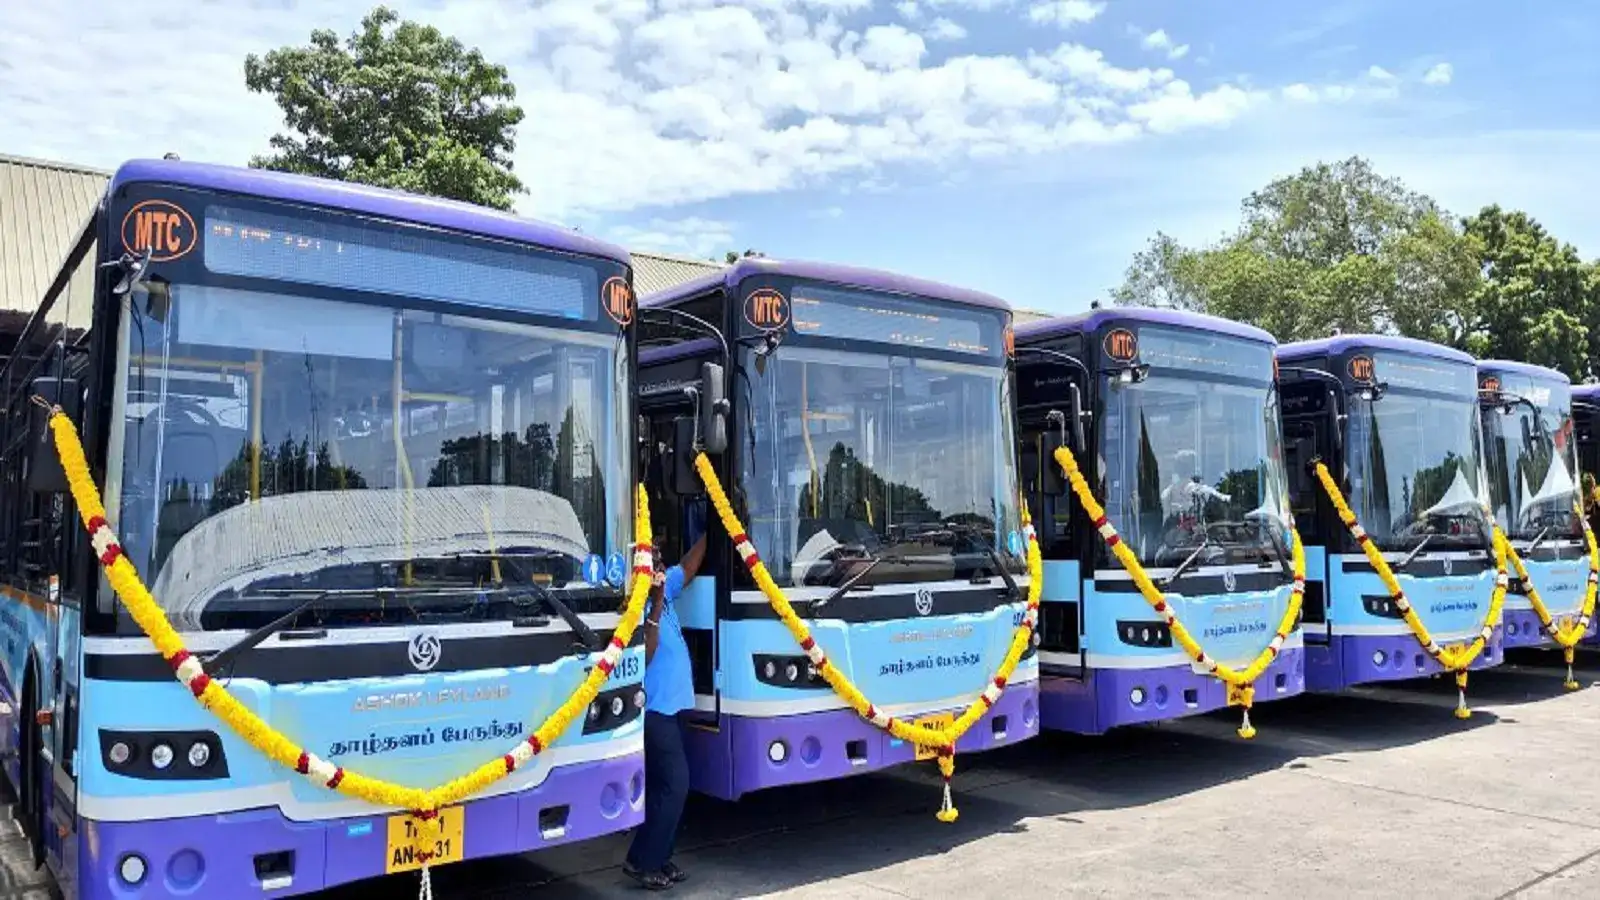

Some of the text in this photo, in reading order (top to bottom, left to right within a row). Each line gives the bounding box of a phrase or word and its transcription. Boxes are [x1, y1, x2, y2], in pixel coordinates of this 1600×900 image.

[135, 211, 181, 252] MTC
[610, 282, 631, 318] MTC
[753, 296, 781, 322] MTC
[1112, 333, 1132, 357] MTC
